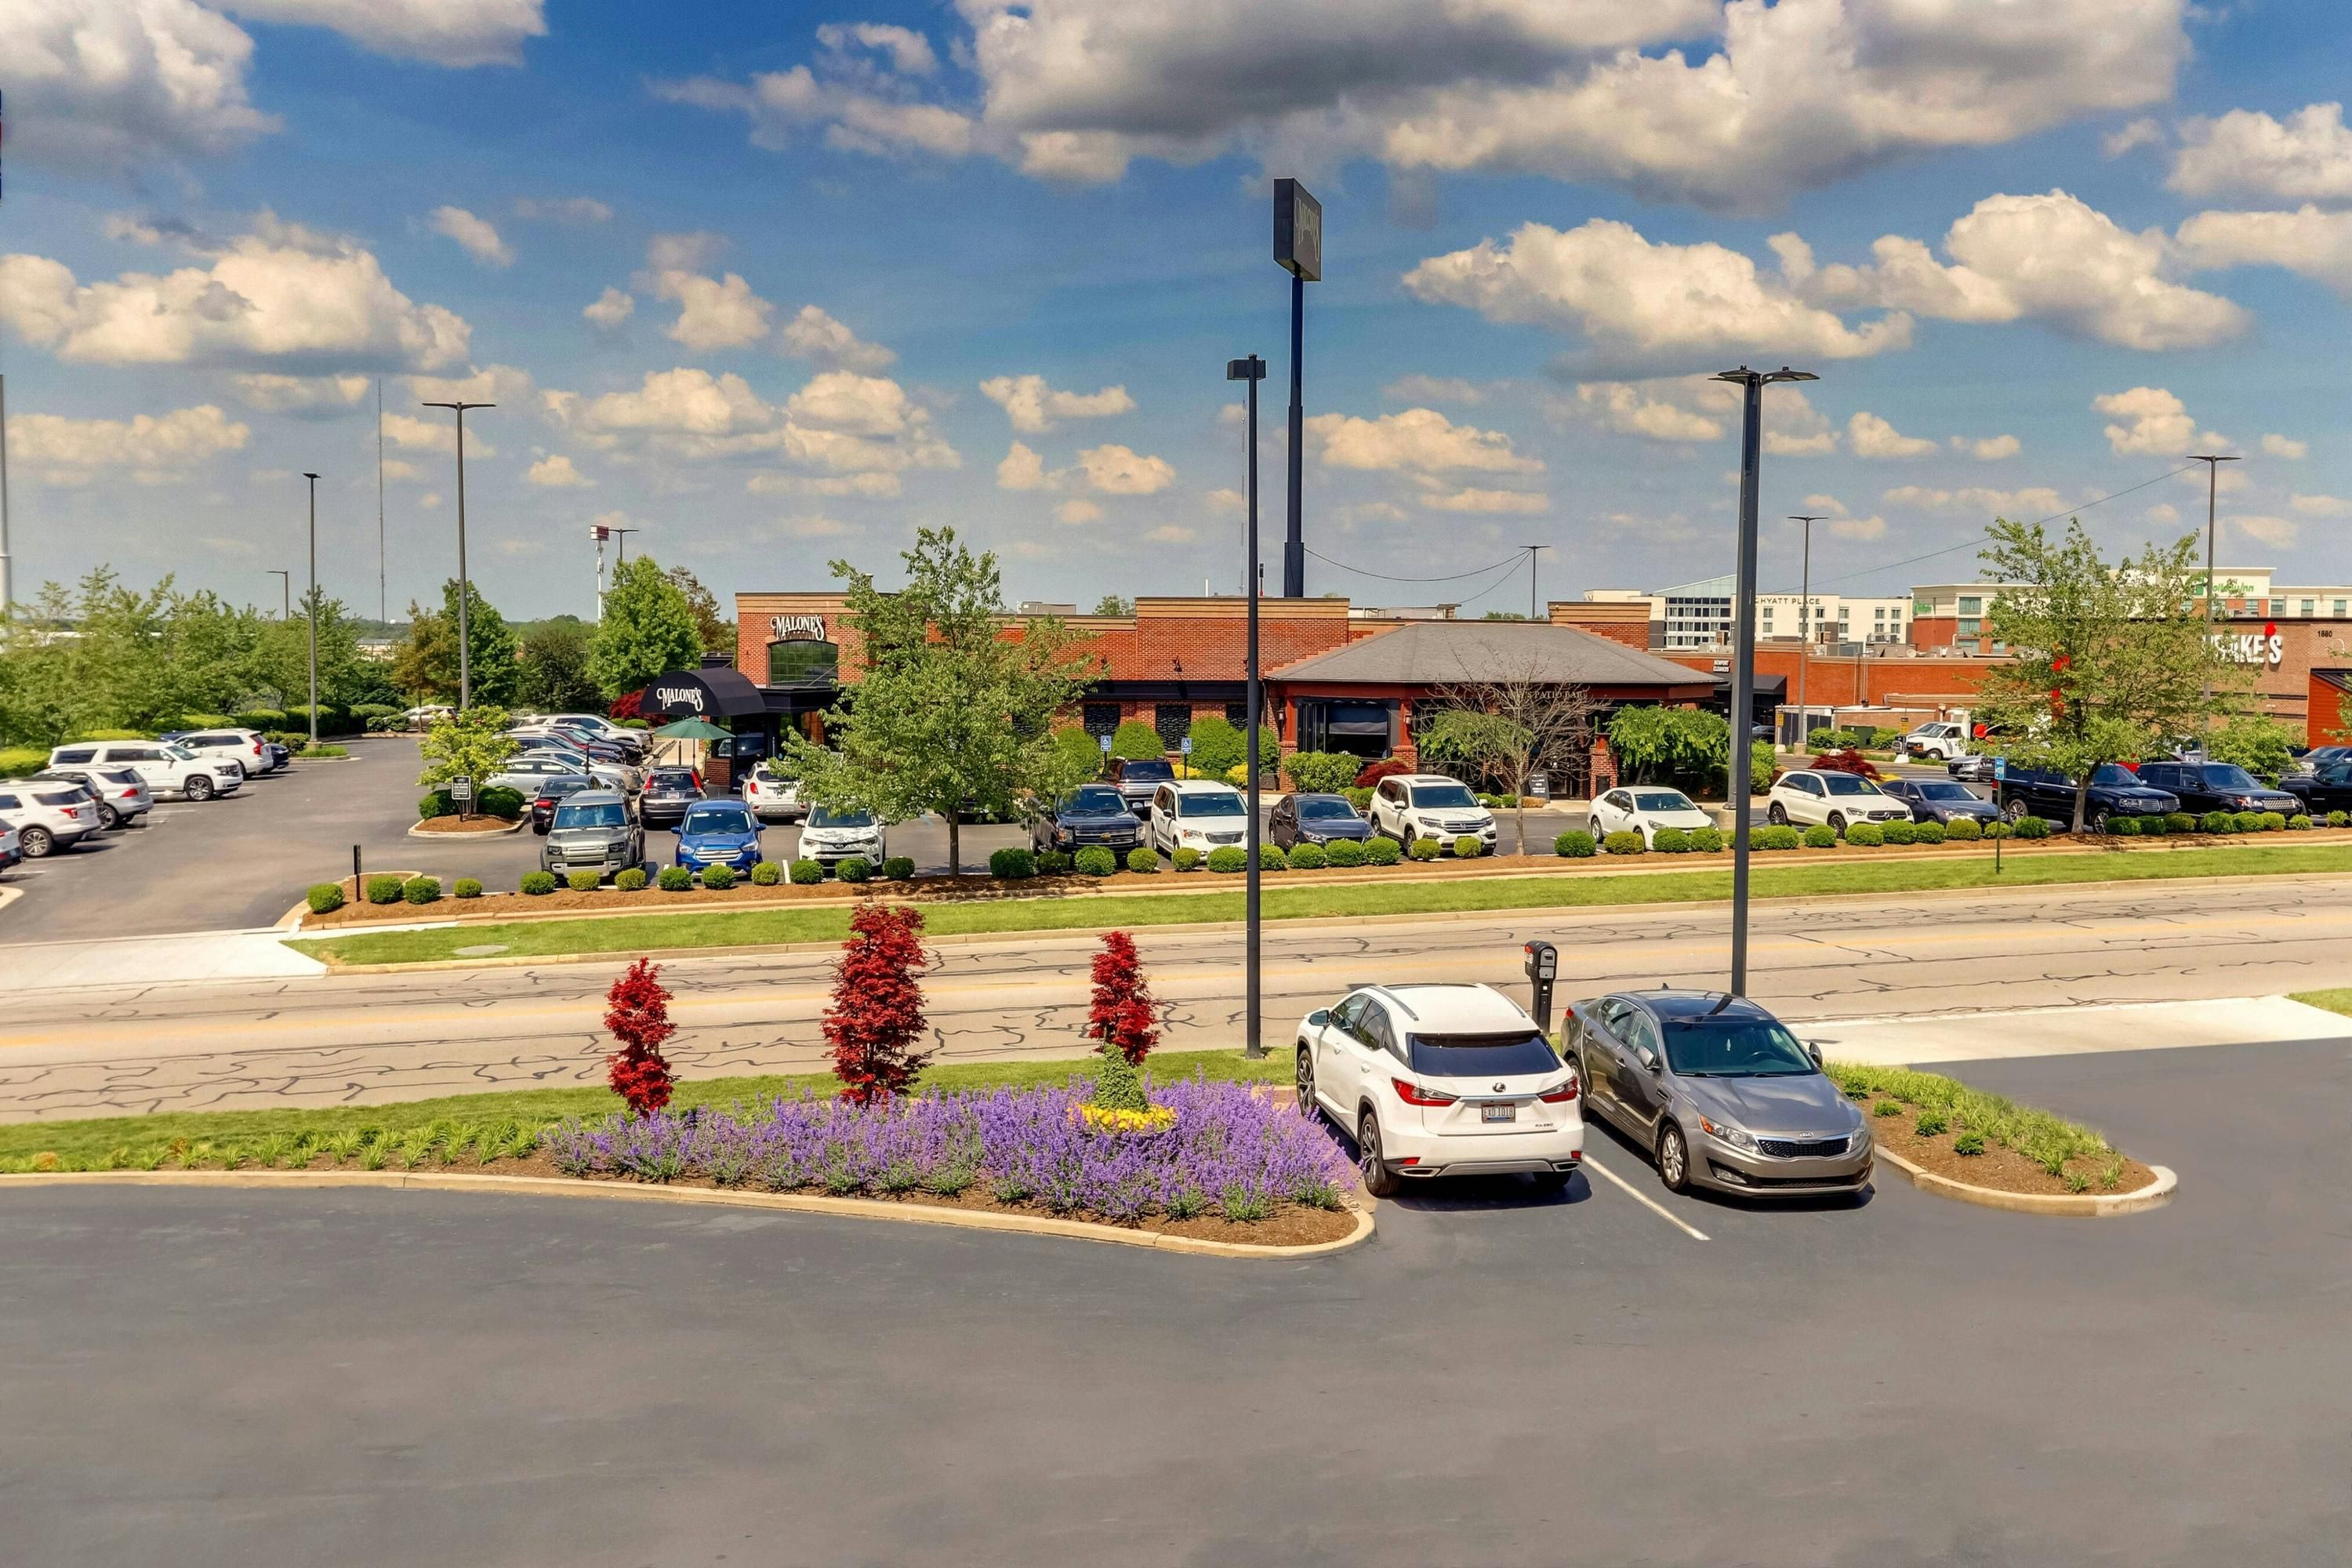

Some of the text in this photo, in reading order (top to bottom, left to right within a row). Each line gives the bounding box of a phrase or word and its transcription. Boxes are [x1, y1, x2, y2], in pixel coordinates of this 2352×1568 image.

[771, 615, 824, 641] MALONE'S
[2202, 622, 2284, 664] AKE'S
[656, 687, 703, 712] MALONE'S
